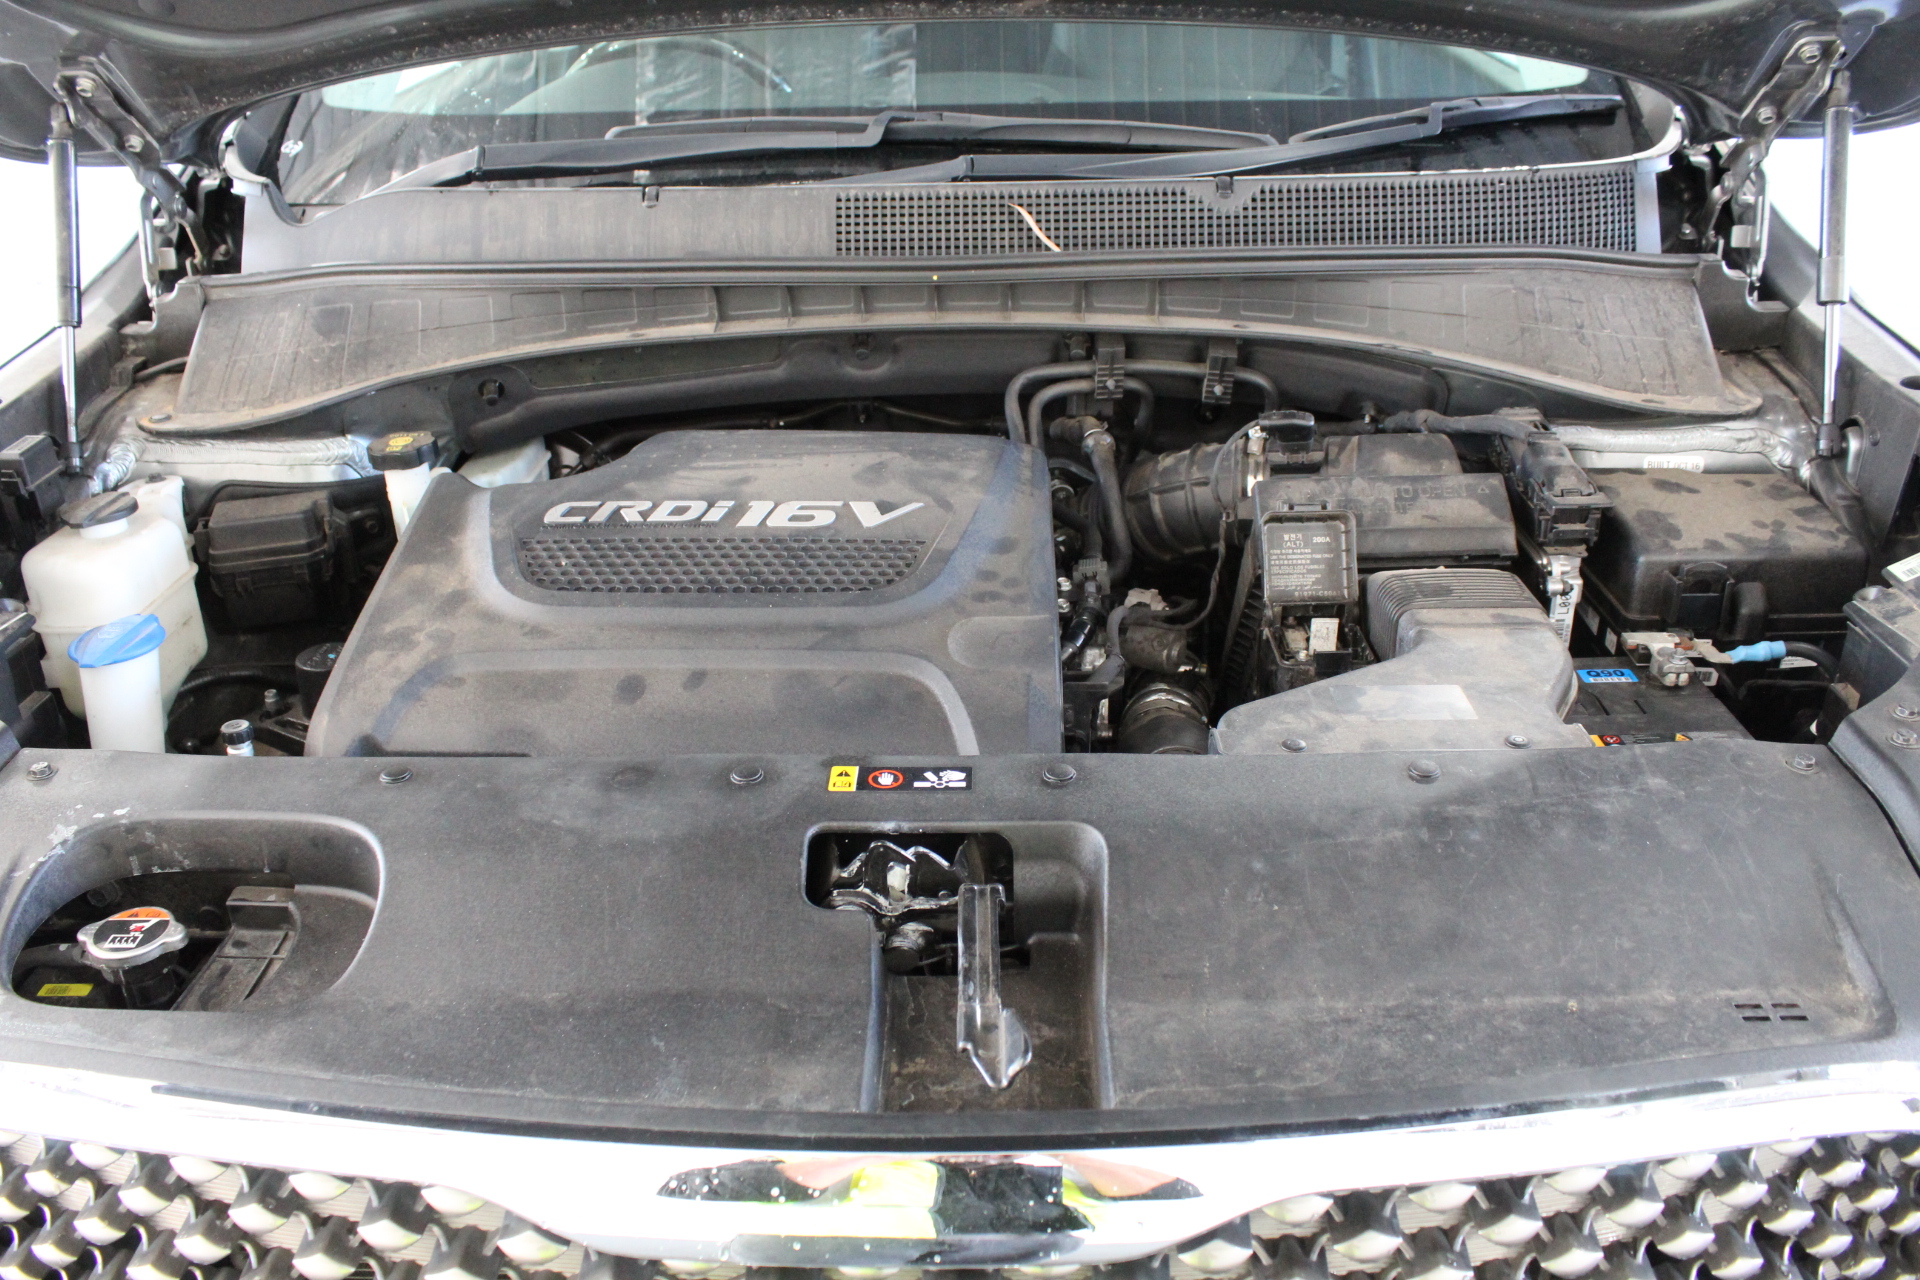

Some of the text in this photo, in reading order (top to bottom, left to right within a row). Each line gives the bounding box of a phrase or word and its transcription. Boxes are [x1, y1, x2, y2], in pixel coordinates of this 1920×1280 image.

[1692, 462, 1701, 471] 16
[1418, 484, 1467, 498] OPEN
[1586, 669, 1625, 678] Q90
